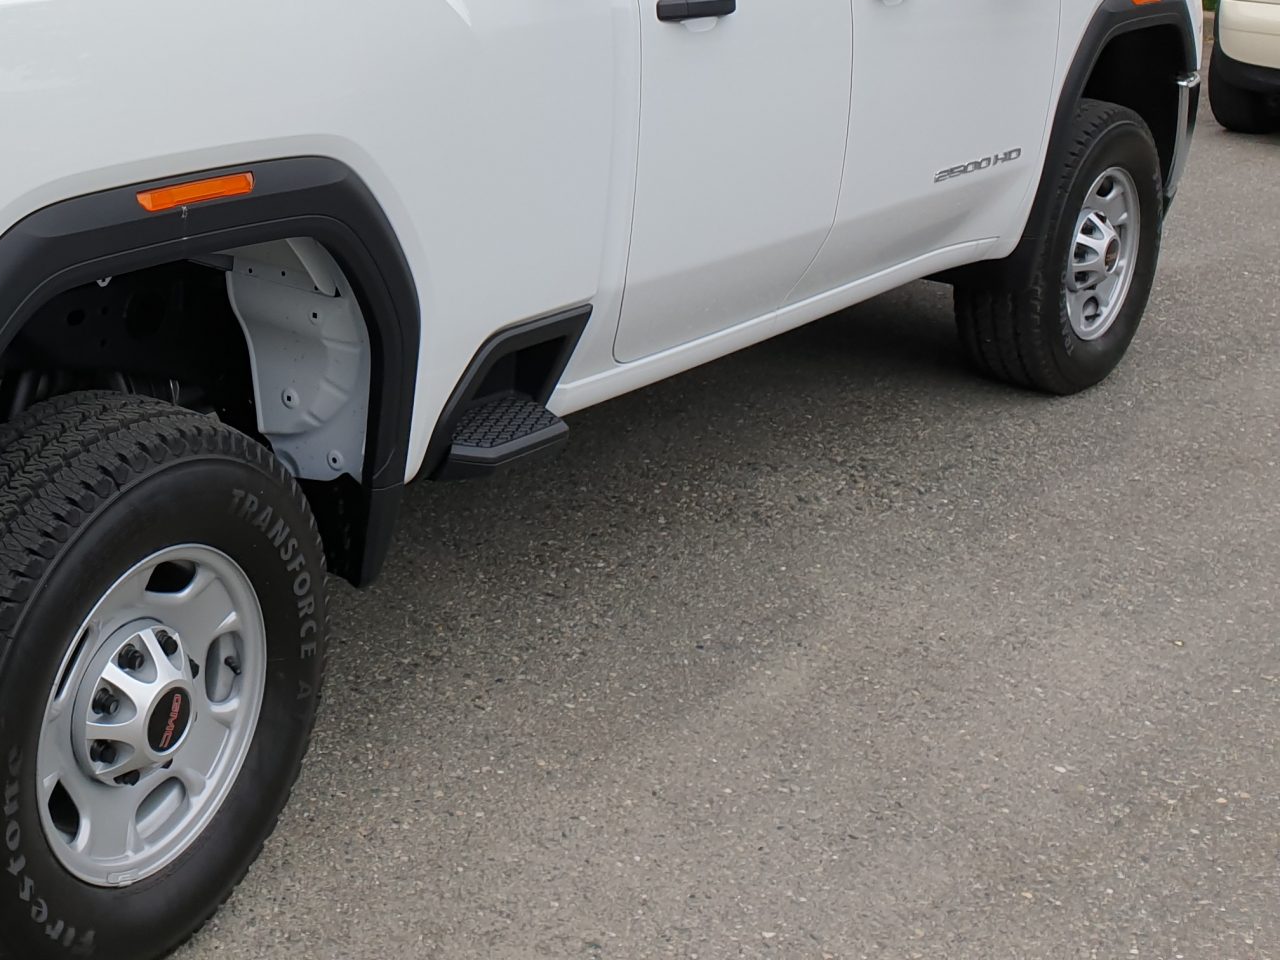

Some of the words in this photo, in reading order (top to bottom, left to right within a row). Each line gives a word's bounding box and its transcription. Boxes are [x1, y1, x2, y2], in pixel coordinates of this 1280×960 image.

[933, 156, 992, 184] 2500
[992, 147, 1022, 167] HD
[230, 488, 318, 660] TRANSFORCE
[158, 693, 182, 749] GMC
